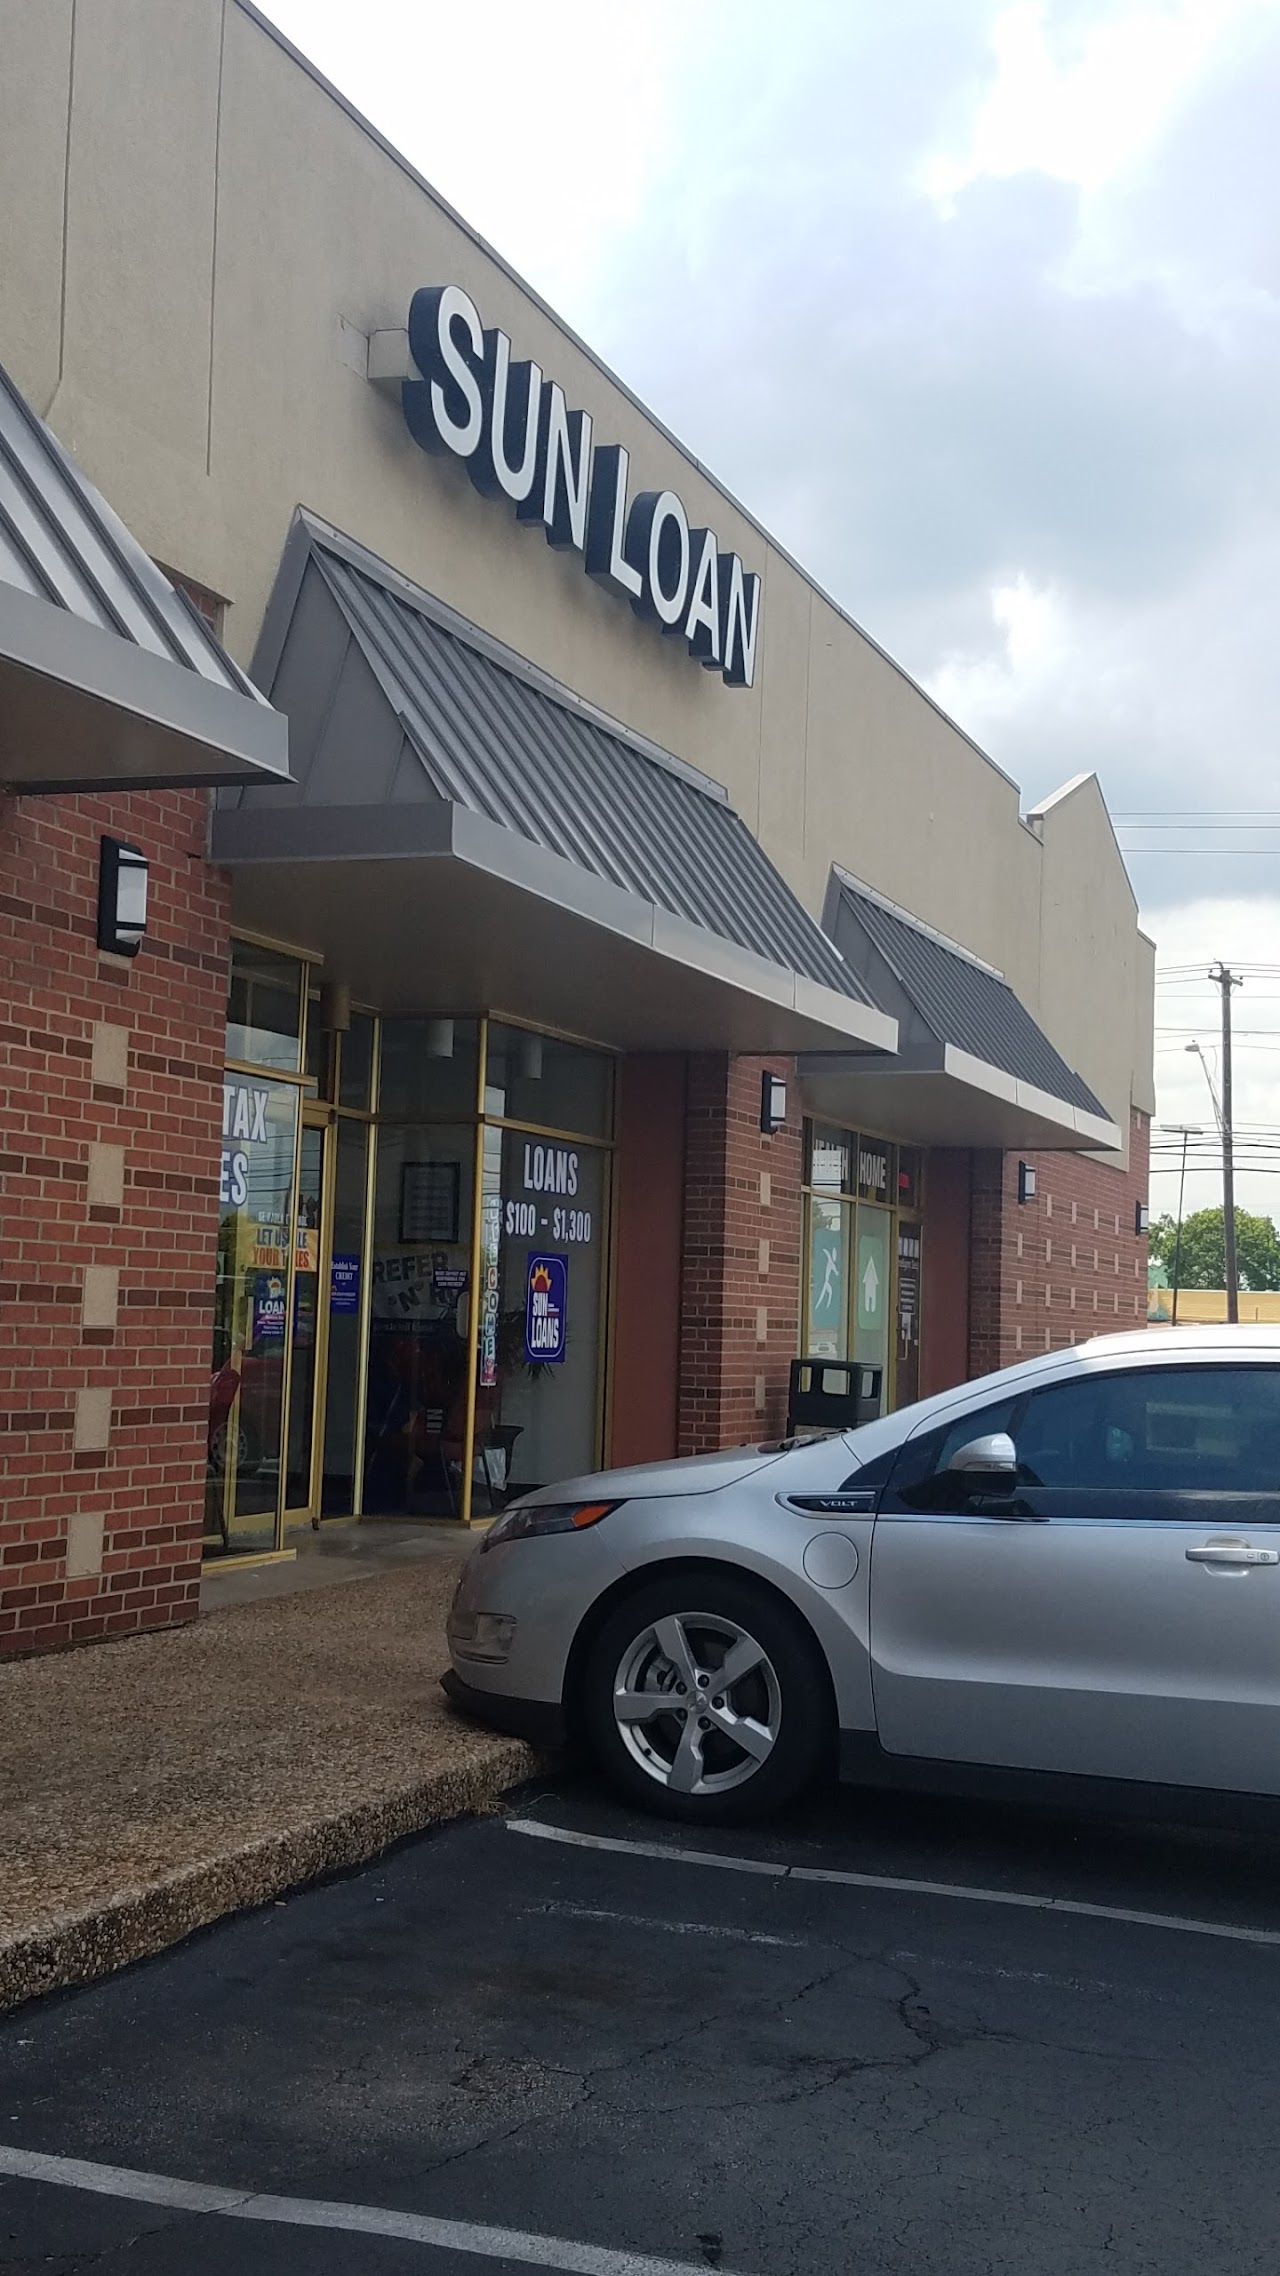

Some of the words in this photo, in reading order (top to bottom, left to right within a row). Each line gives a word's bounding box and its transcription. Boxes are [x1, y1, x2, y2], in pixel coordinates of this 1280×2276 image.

[425, 284, 593, 551] SUN
[604, 443, 762, 688] LOAN
[223, 1083, 269, 1144] TAX
[523, 1143, 579, 1196] LOANS
[859, 1151, 886, 1190] HOME
[256, 1227, 273, 1245] LET
[275, 1228, 288, 1247] US
[505, 1200, 536, 1237] $100
[552, 1206, 592, 1244] $1,300
[252, 1246, 280, 1266] YOUR
[281, 1249, 310, 1269] TES
[532, 1291, 549, 1317] SUN
[531, 1316, 560, 1349] LOANS
